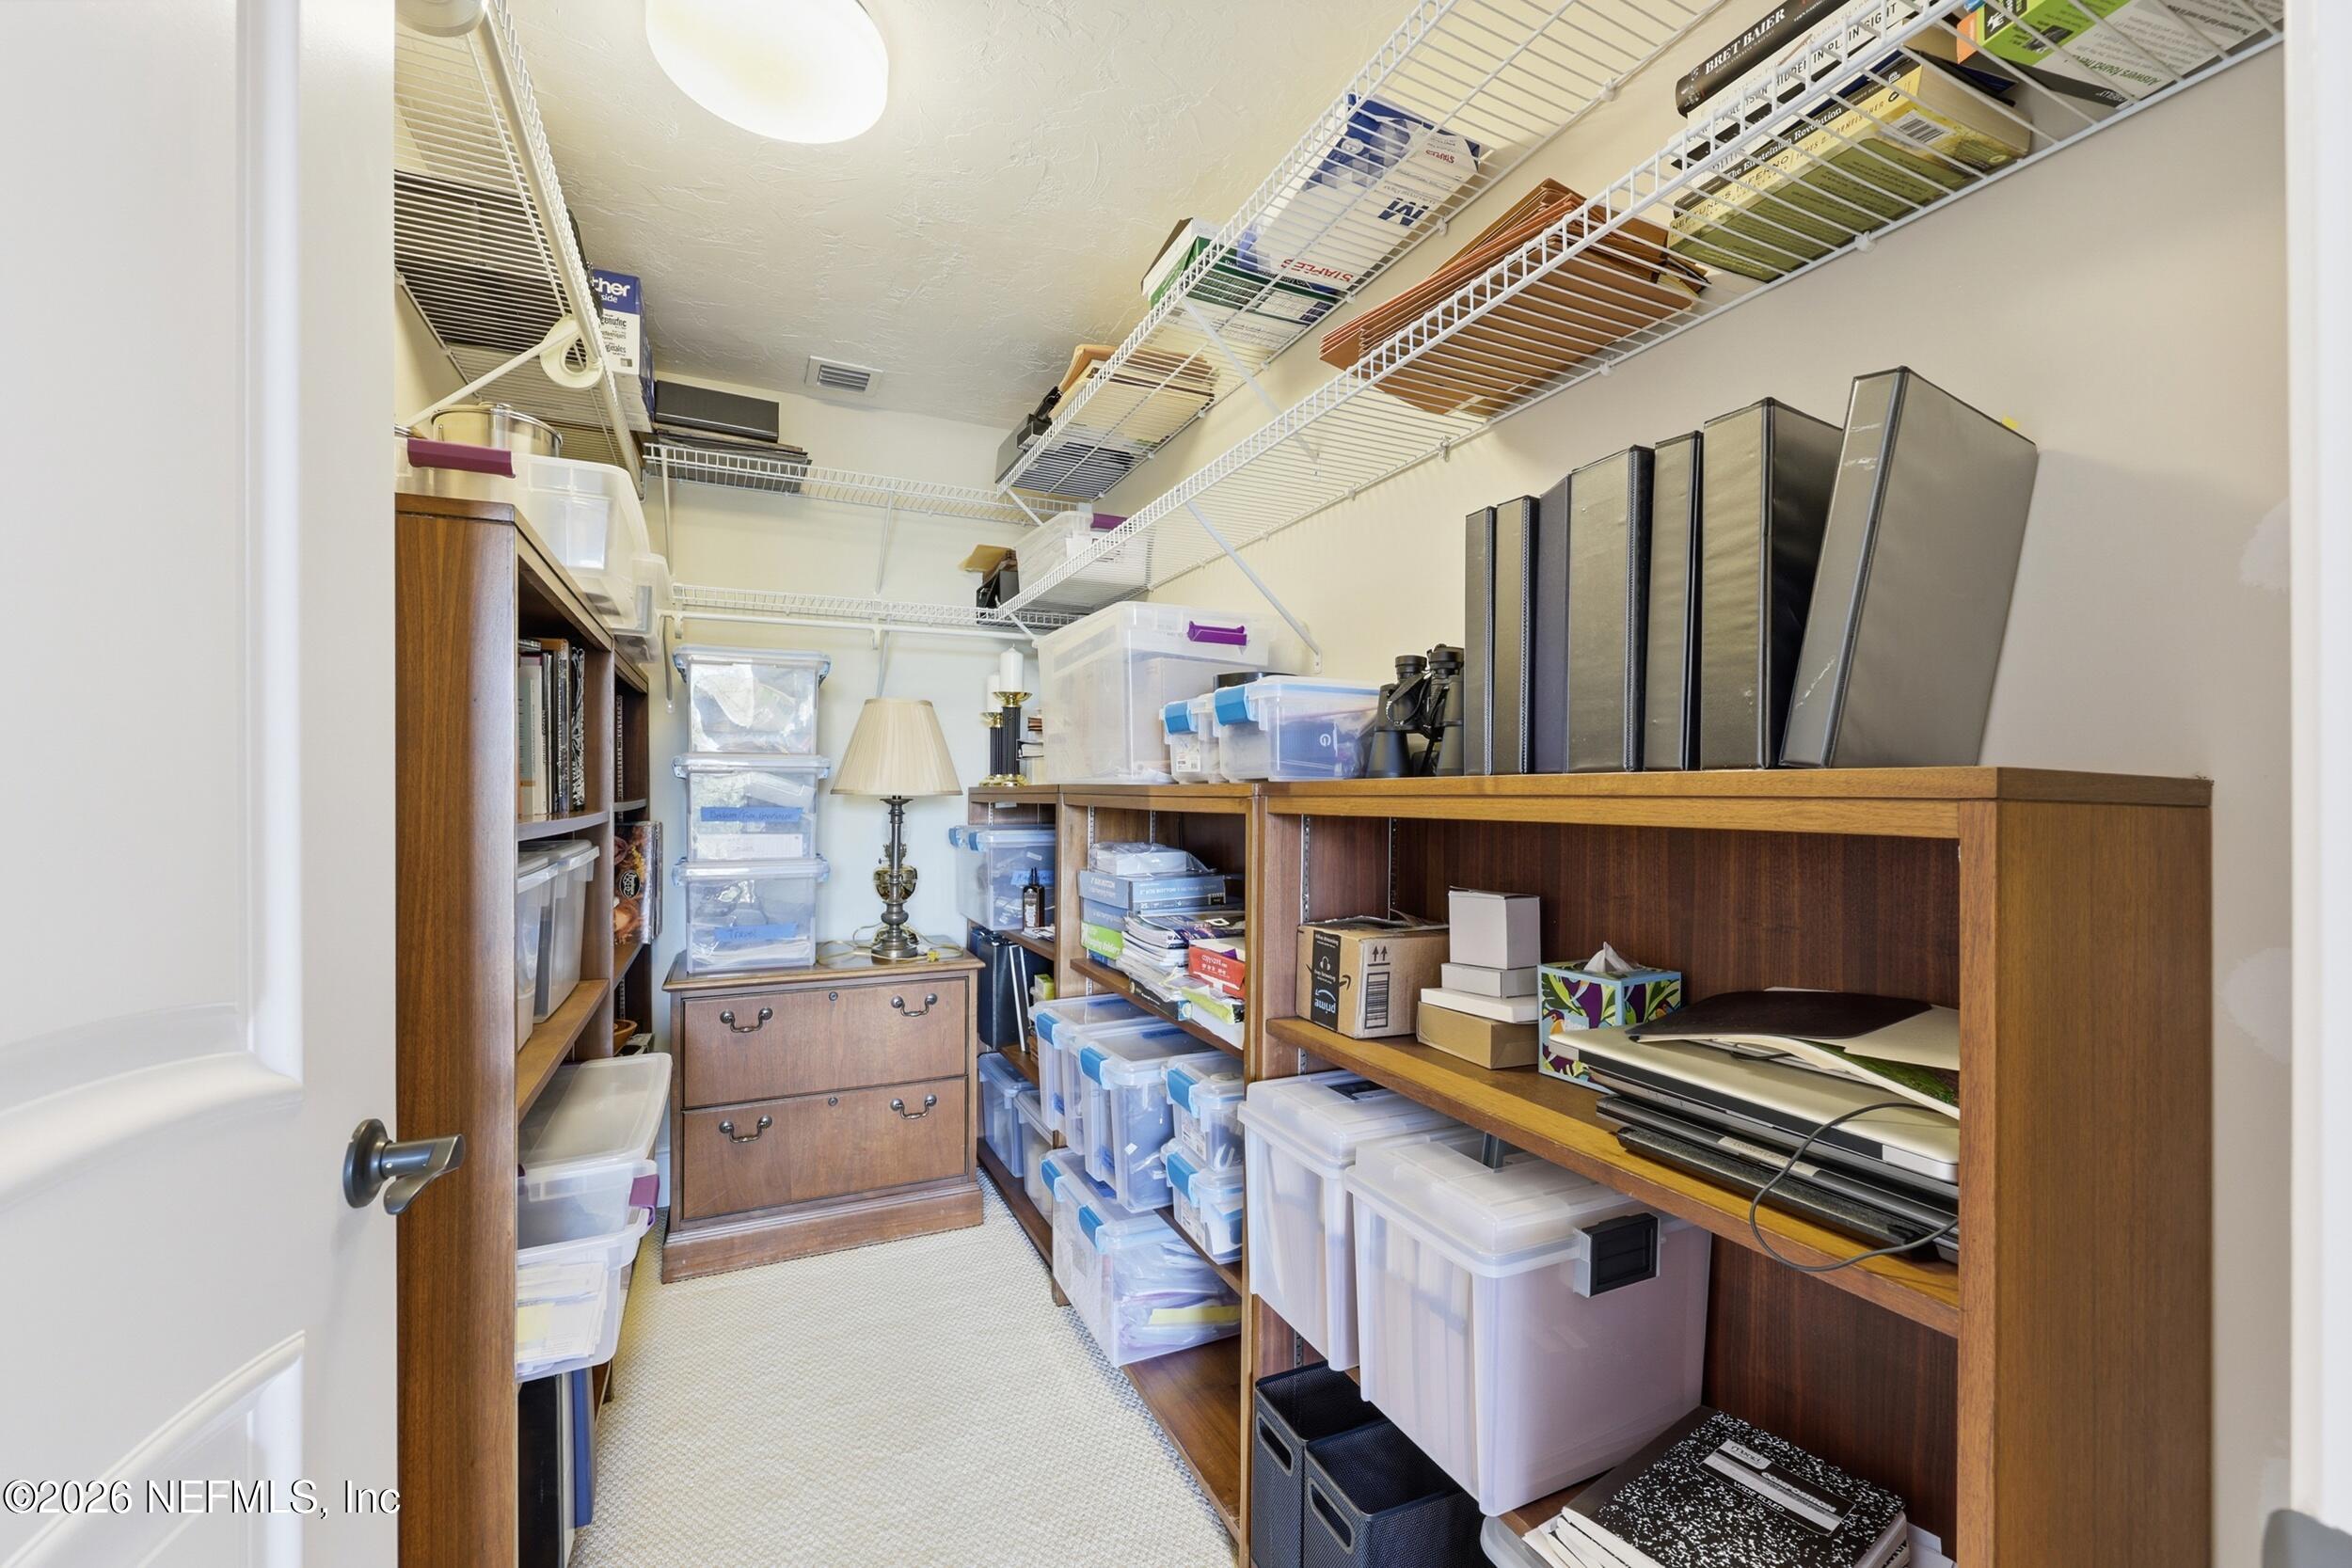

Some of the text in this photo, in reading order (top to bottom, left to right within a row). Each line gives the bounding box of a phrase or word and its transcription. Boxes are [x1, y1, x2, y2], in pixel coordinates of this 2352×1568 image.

[1705, 42, 1741, 75] BRET
[1742, 8, 1786, 48] BAIER
[1813, 49, 1824, 63] IN
[1828, 25, 1860, 51] PLIN
[1743, 137, 1792, 170] Einteinin
[1793, 107, 1842, 141] Revoution
[1377, 197, 1429, 227] M
[592, 277, 631, 297] ther
[1314, 998, 1337, 1014] prime
[1733, 1481, 1757, 1497] WIDE
[1757, 1493, 1786, 1513] RULED
[1761, 1471, 1836, 1513] COMPOSITION
